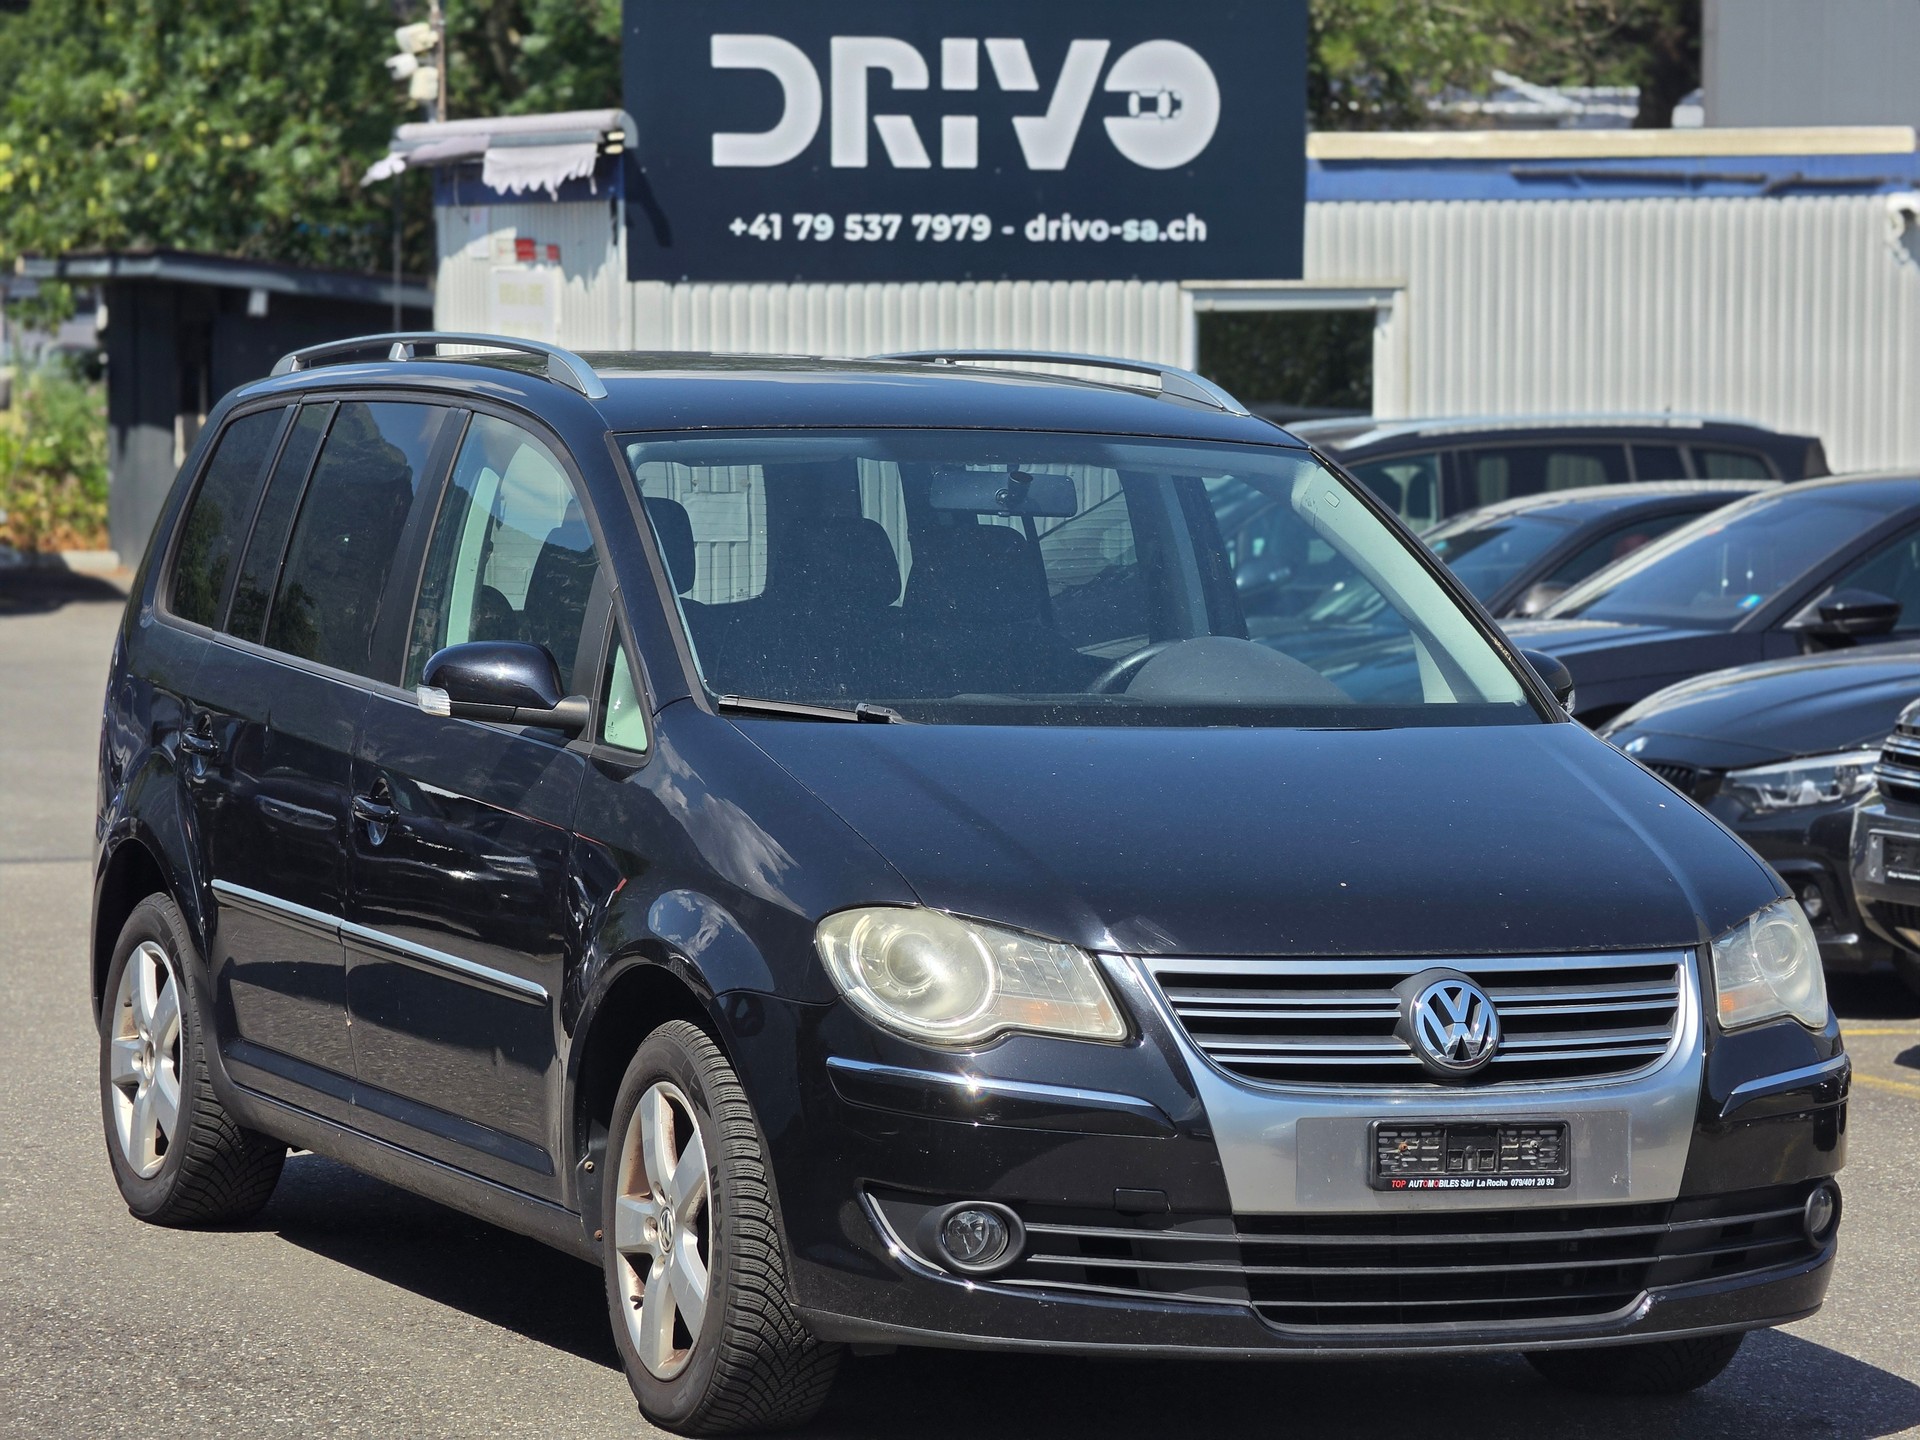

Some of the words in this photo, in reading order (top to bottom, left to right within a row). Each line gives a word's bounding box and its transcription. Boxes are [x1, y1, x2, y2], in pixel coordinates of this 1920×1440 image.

[711, 33, 1220, 170] DRIVO
[729, 212, 781, 241] +41
[793, 212, 834, 241] 79
[844, 213, 902, 241] 537
[912, 213, 991, 241] 7979
[1002, 225, 1014, 234] -
[1025, 212, 1206, 241] drivo-sa.ch
[1391, 1180, 1406, 1188] TOP
[1408, 1179, 1459, 1188] AUTOMOBILES
[1476, 1179, 1485, 1187] La
[1486, 1178, 1508, 1187] Roche
[1536, 1178, 1545, 1186] 20
[1546, 1178, 1555, 1186] 93
[710, 1165, 723, 1298] NEXEN
